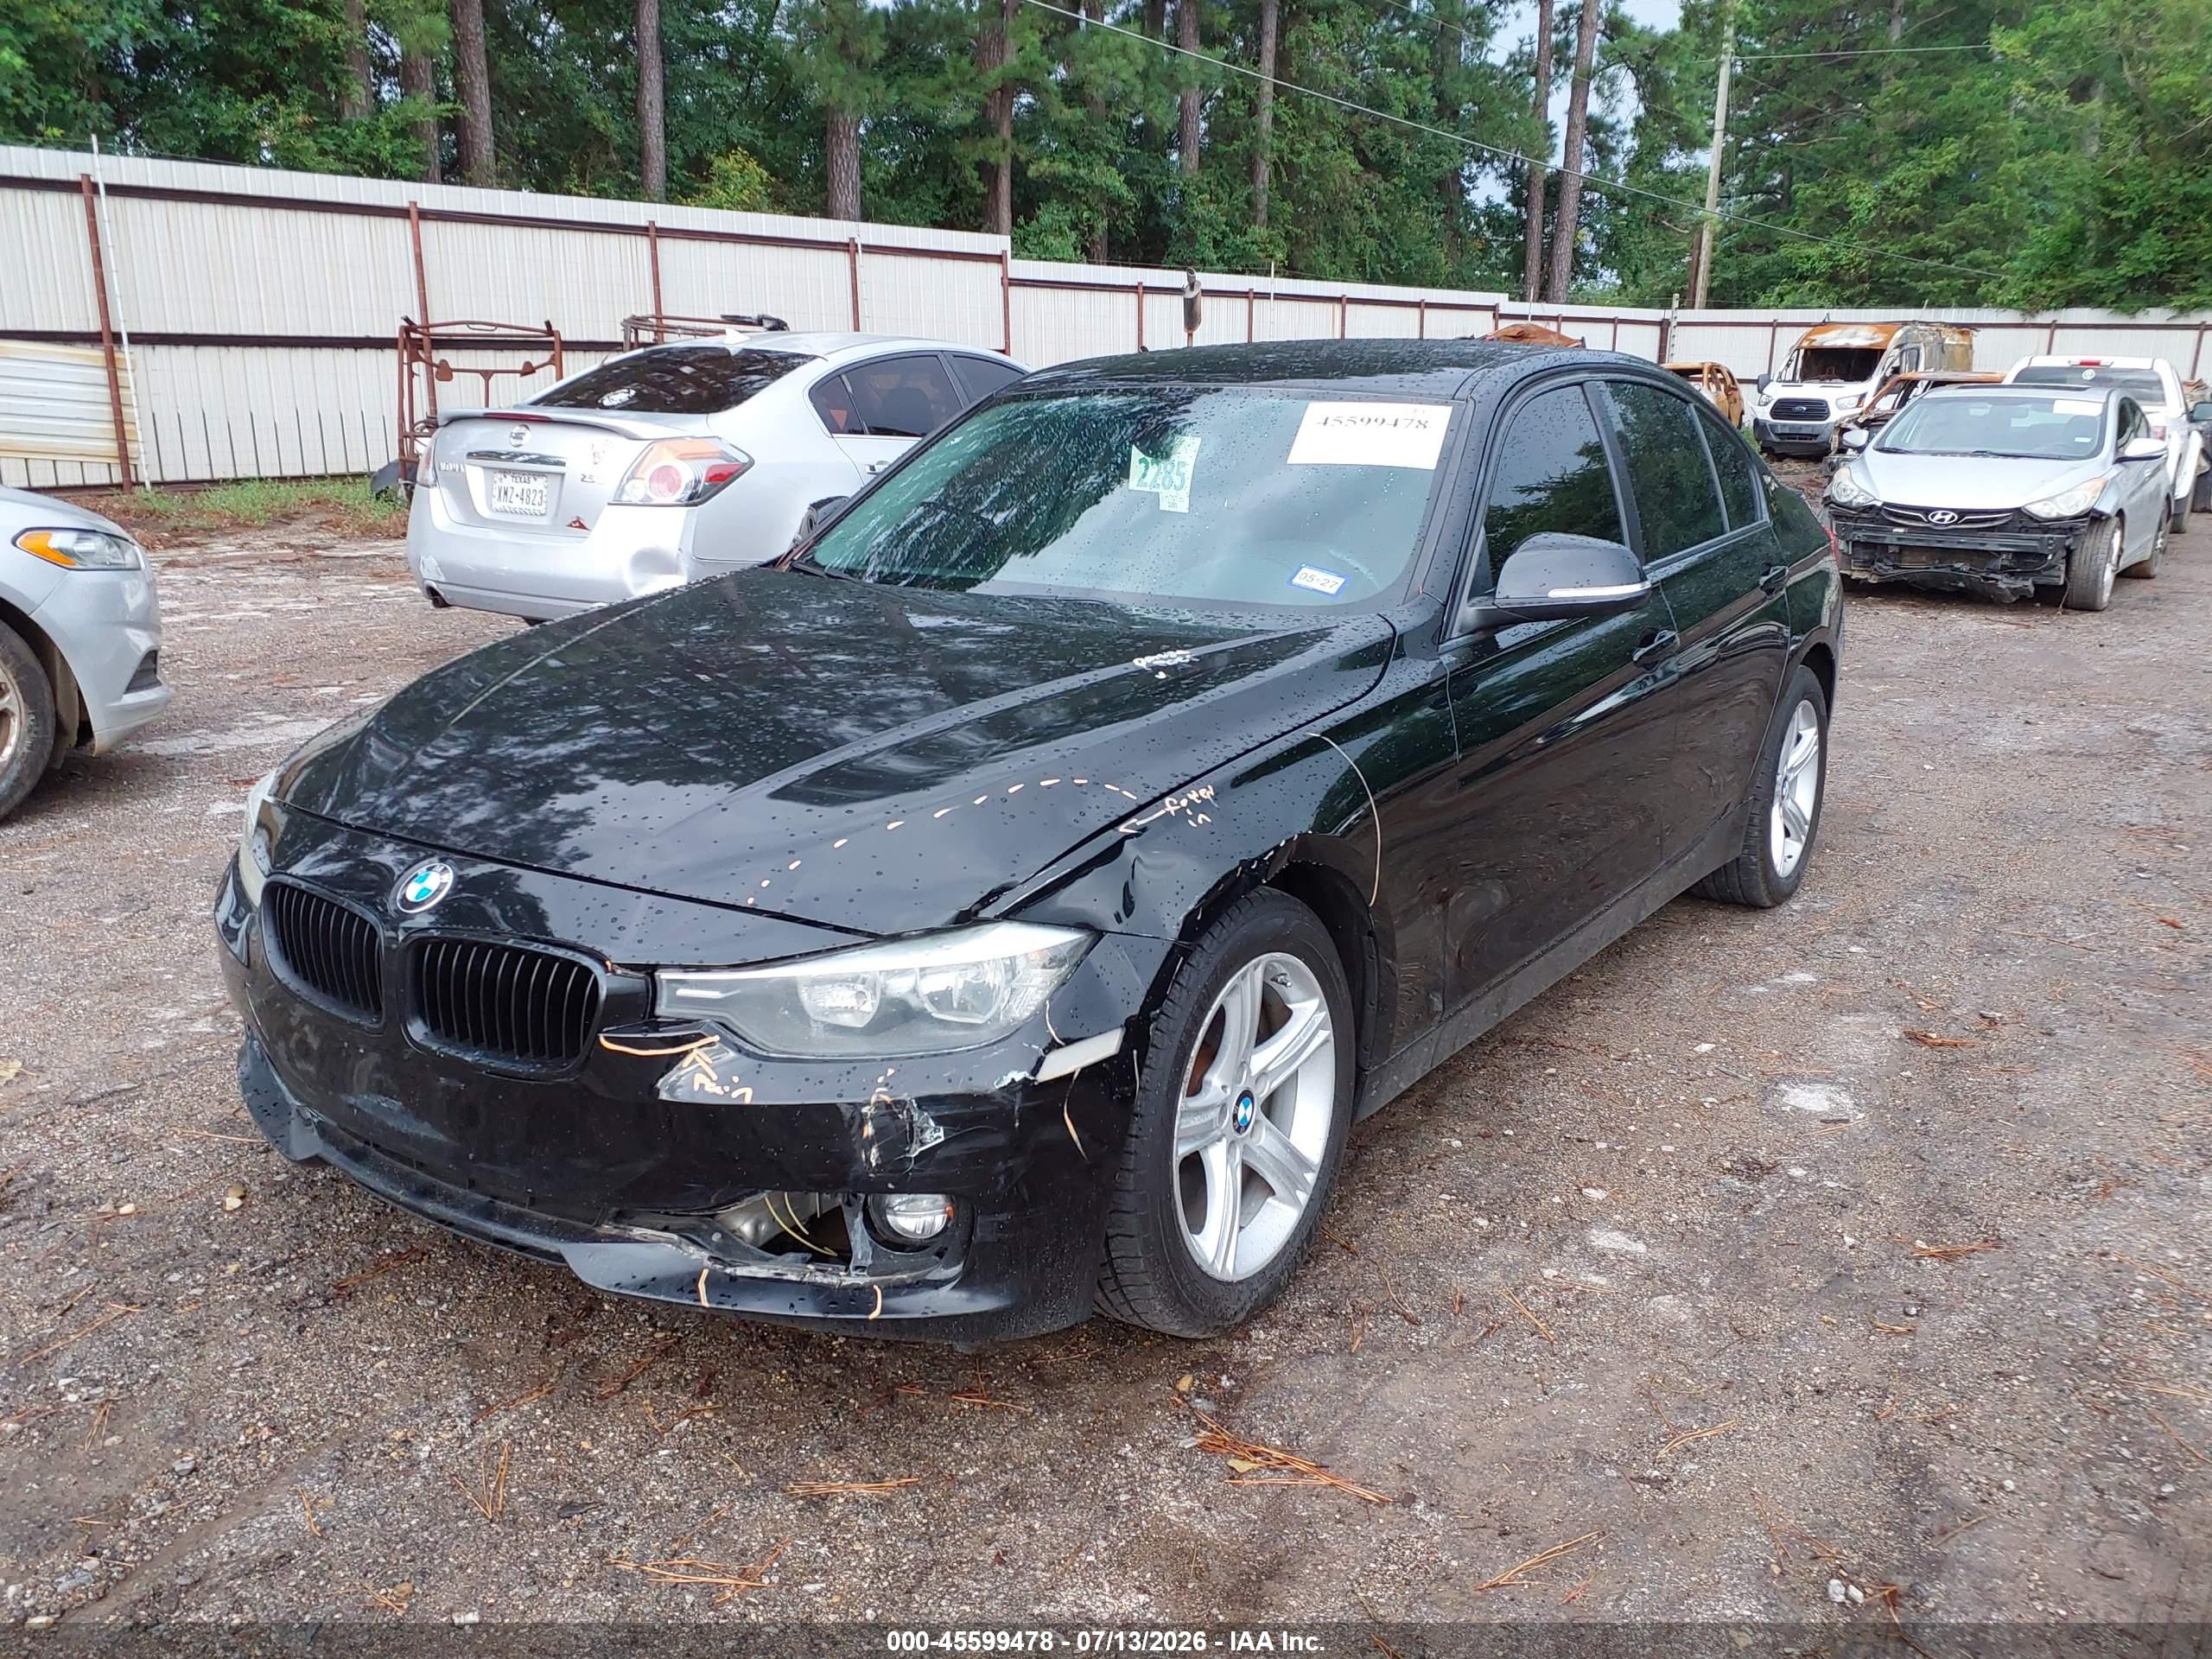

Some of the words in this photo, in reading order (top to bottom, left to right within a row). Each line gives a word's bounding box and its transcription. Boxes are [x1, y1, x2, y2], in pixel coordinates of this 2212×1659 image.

[1317, 416, 1429, 429] 45599478
[511, 475, 531, 485] TEXAS
[1136, 456, 1187, 492] 2285
